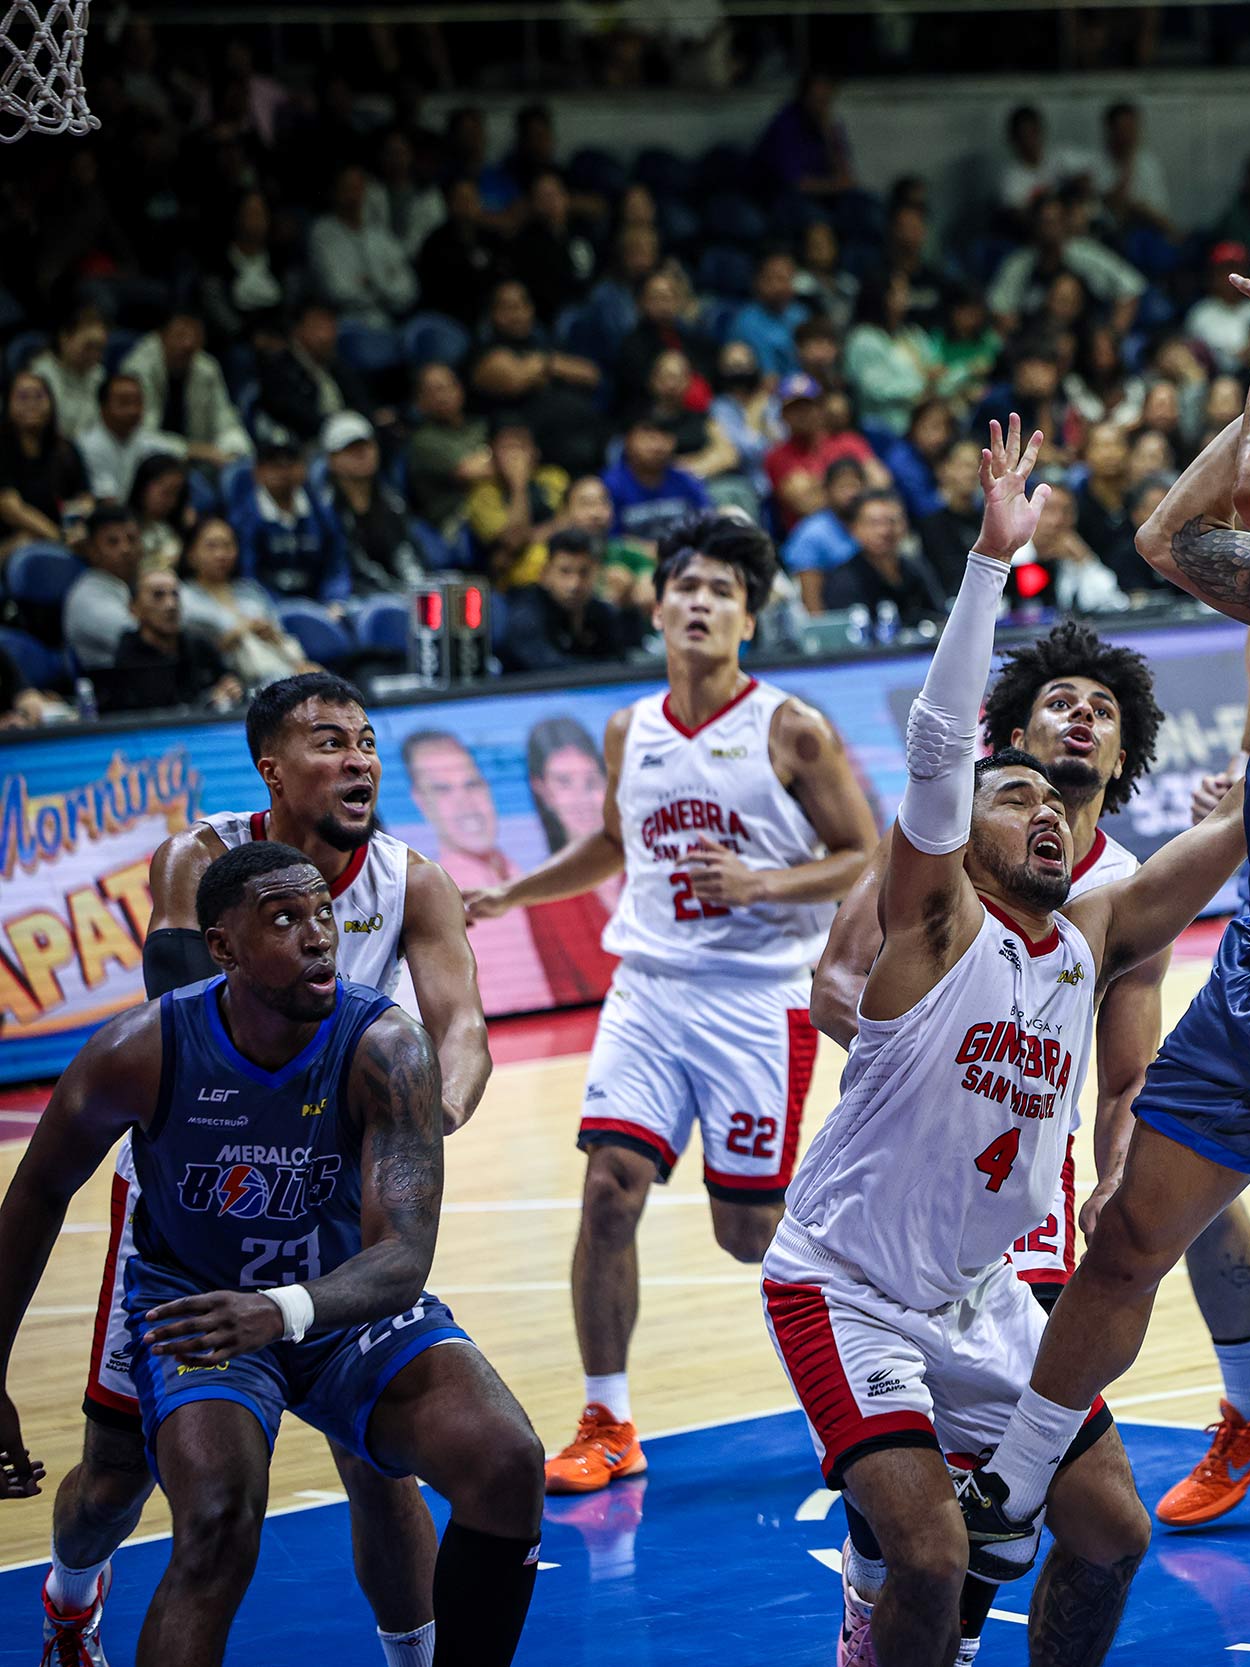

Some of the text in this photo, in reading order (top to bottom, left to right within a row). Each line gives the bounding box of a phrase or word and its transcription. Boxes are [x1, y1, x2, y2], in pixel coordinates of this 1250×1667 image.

[641, 798, 751, 850] GINEBRA
[955, 1020, 1072, 1100] GINEBRA
[961, 1063, 1012, 1105] SAN
[726, 1111, 776, 1159] 22
[974, 1126, 1022, 1193] 4
[240, 1223, 322, 1288] 23
[869, 1378, 901, 1391] WORLD
